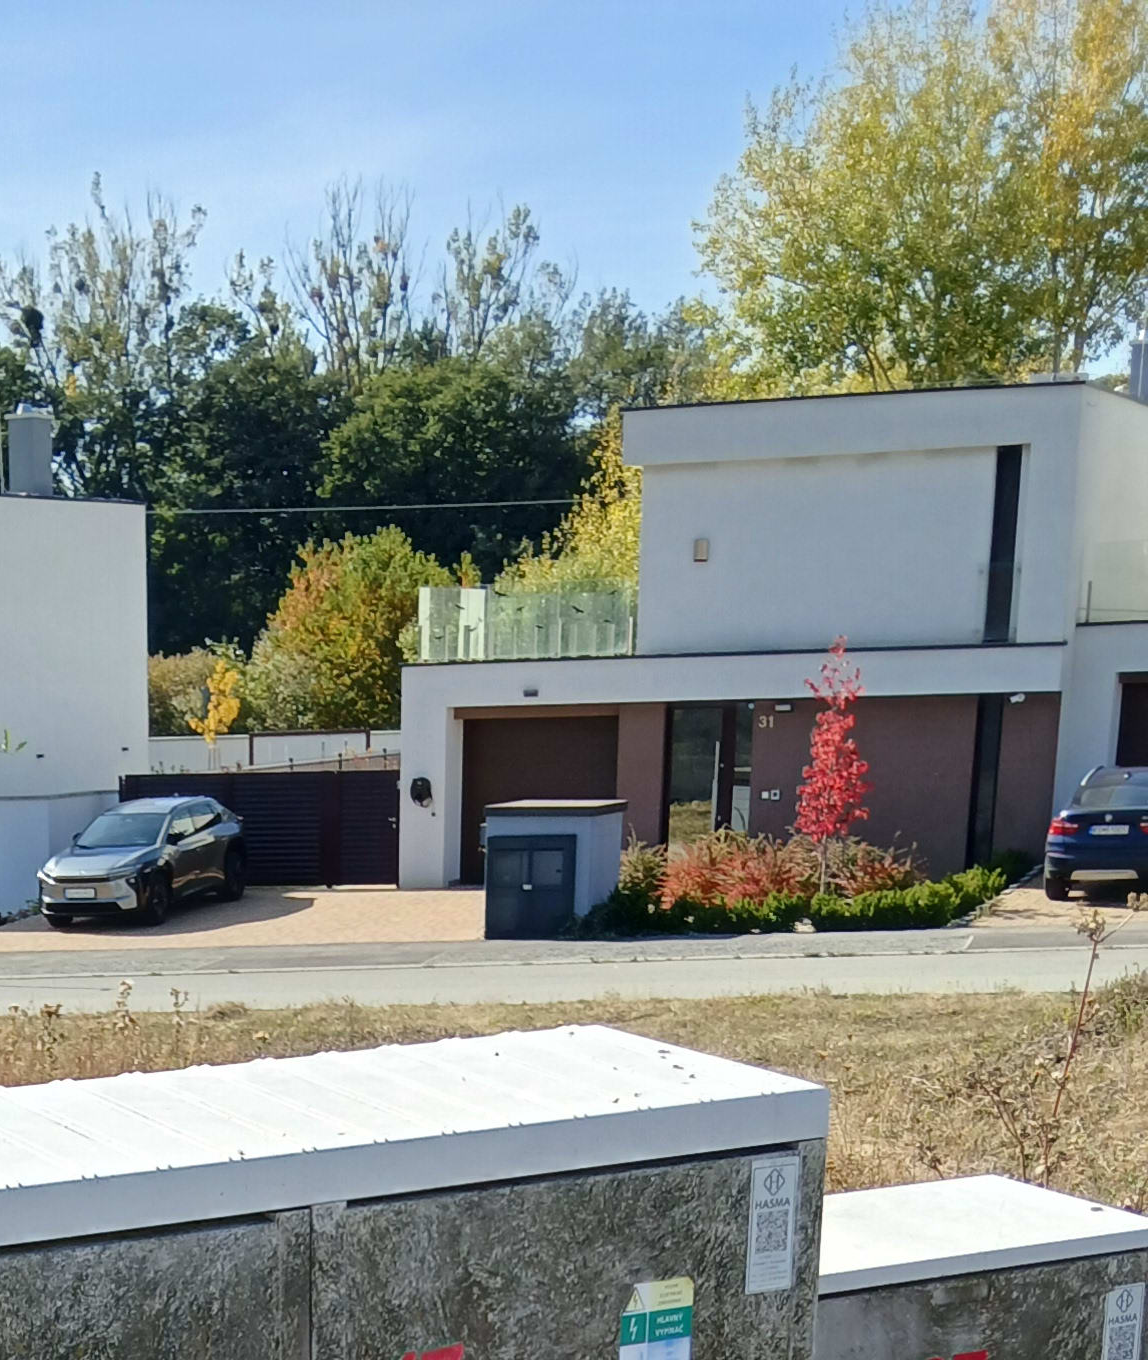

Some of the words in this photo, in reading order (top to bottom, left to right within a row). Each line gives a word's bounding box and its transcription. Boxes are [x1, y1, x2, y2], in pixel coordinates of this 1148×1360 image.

[758, 715, 774, 728] 31
[755, 1197, 790, 1210] HASMA
[1108, 1313, 1138, 1325] HASMA
